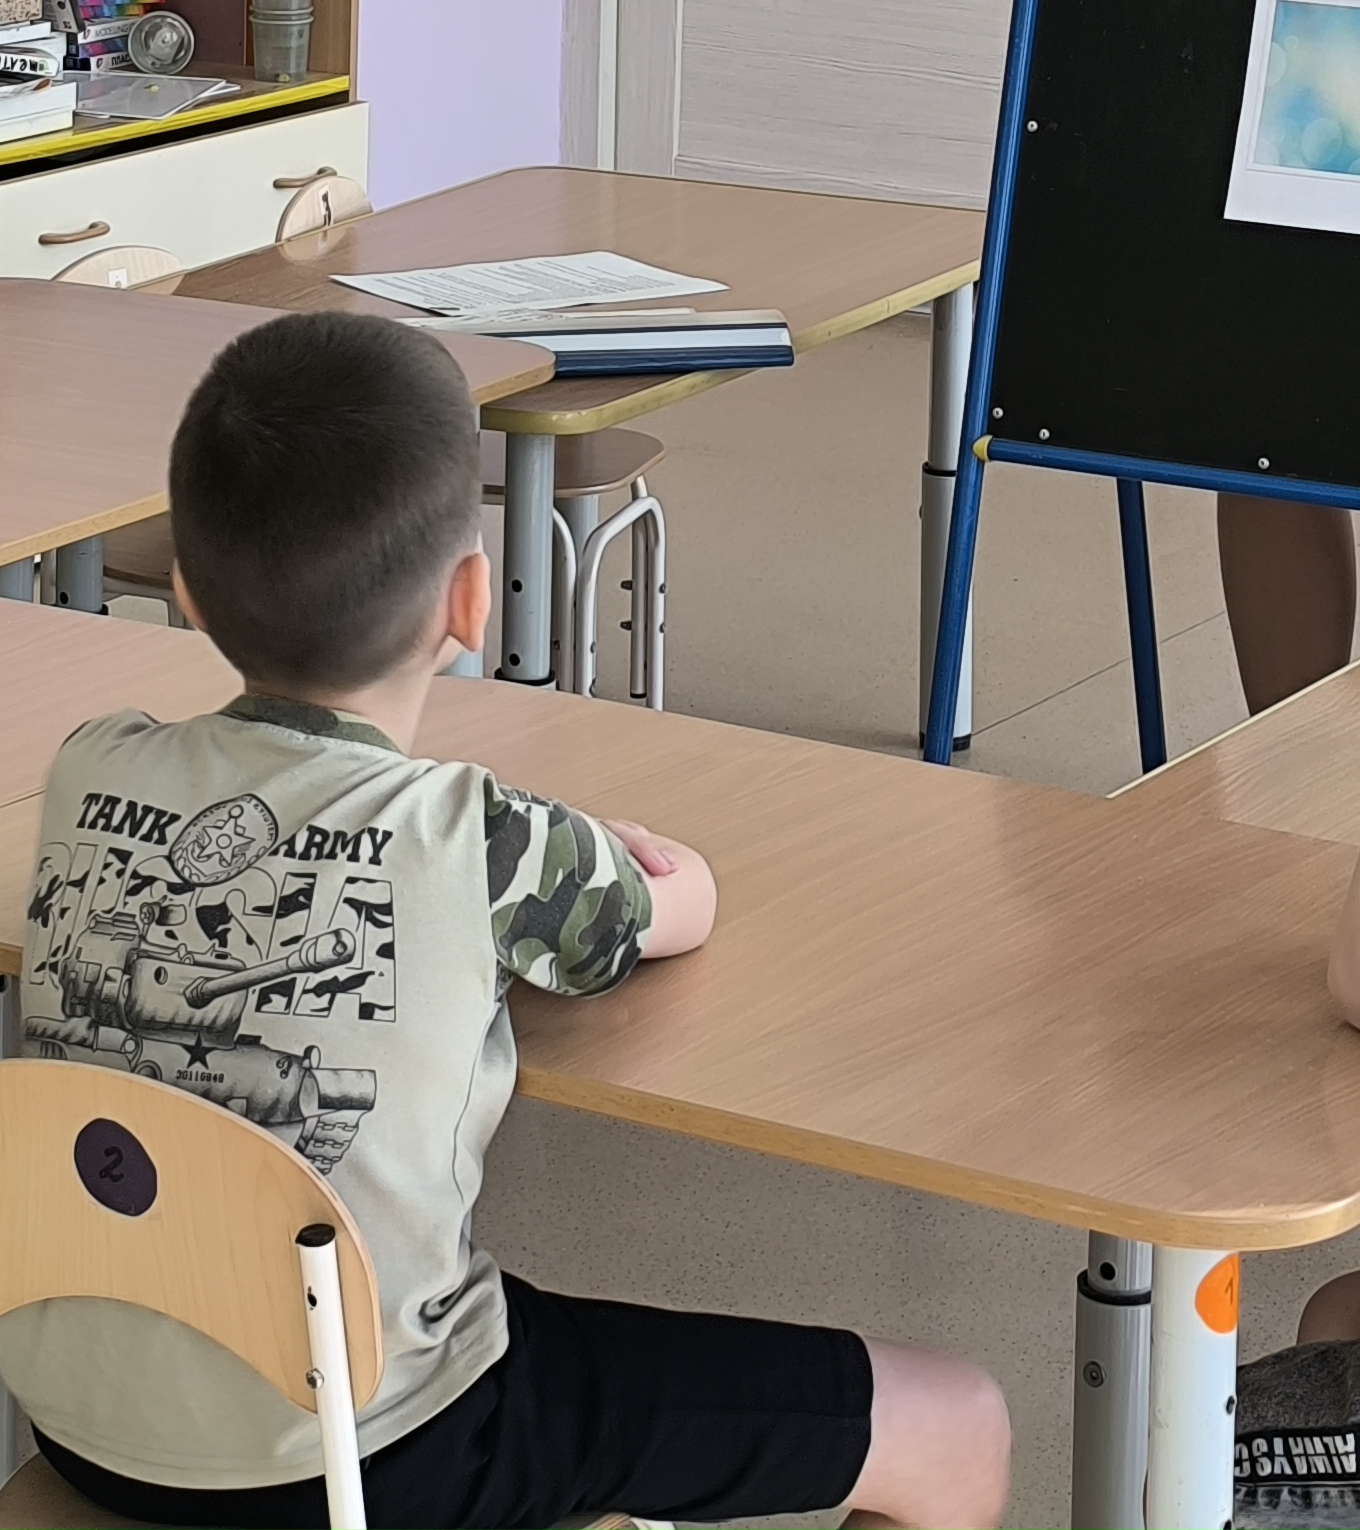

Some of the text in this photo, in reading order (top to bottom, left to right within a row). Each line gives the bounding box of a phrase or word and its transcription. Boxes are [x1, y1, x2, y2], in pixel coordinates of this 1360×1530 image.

[76, 792, 182, 846] TANK
[267, 823, 394, 866] ARMY
[98, 1145, 124, 1183] 2
